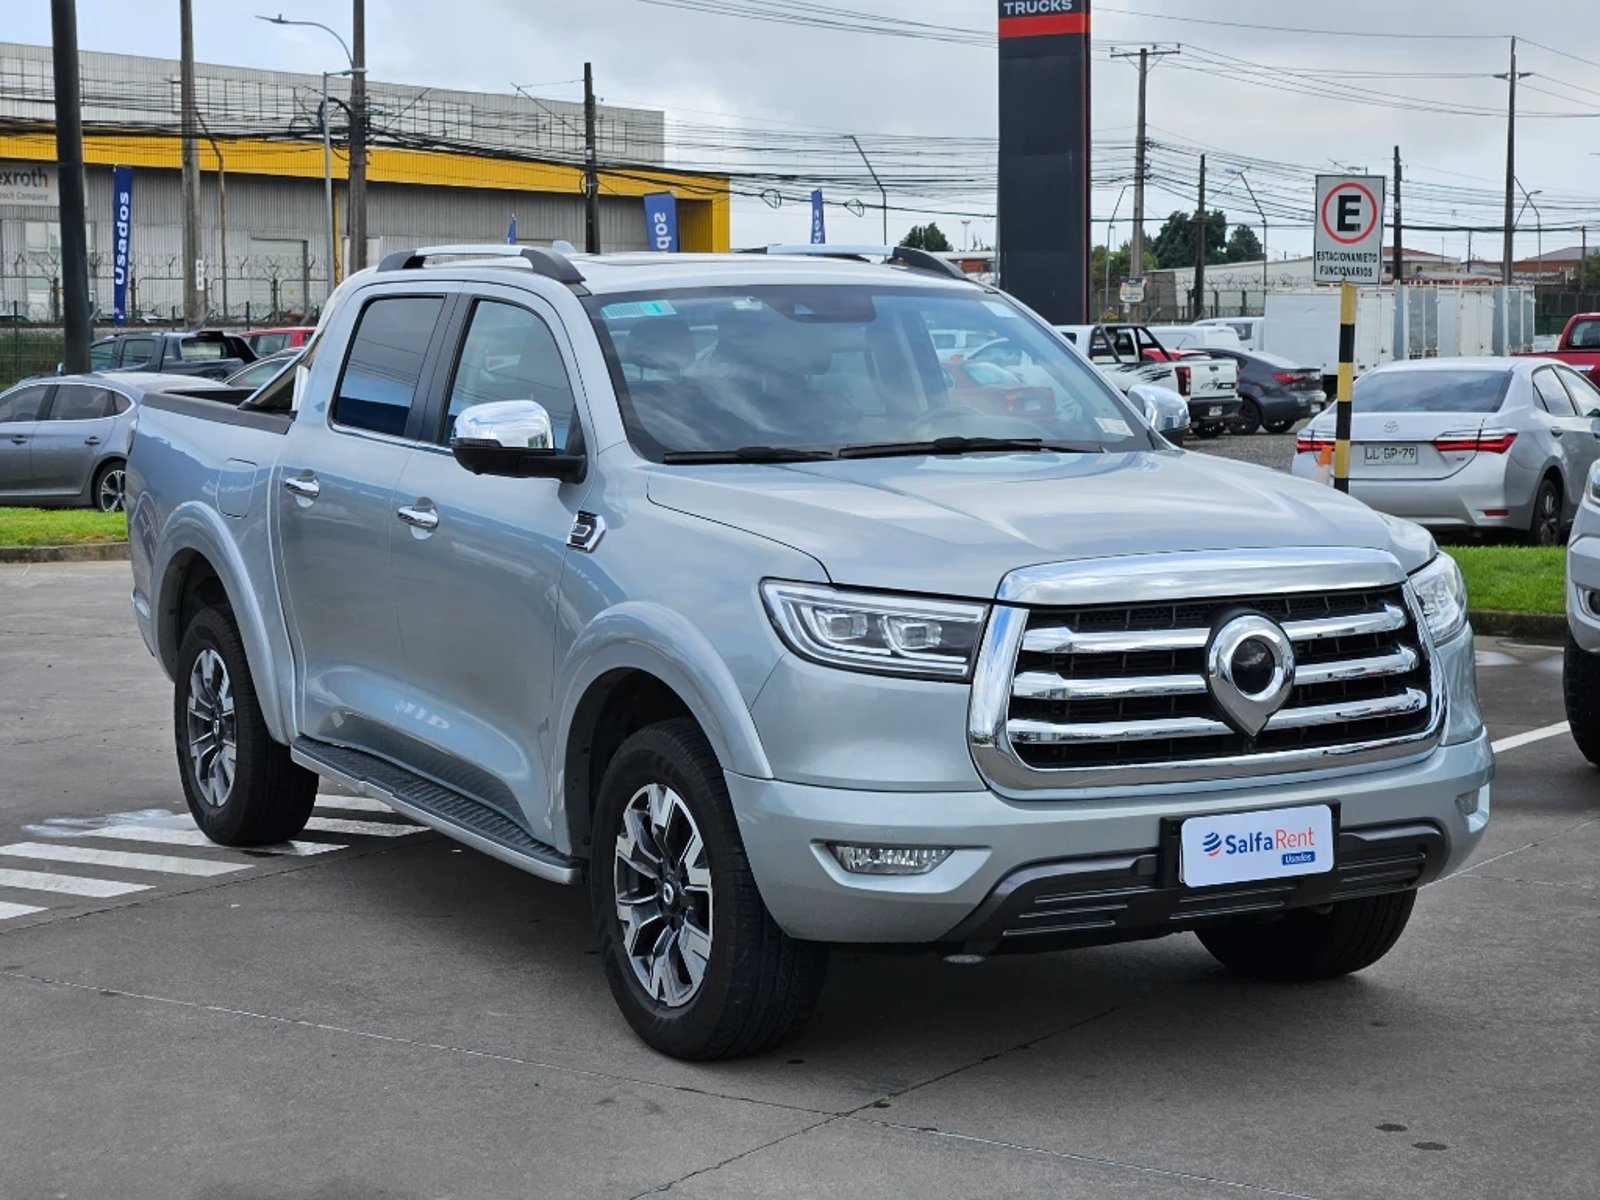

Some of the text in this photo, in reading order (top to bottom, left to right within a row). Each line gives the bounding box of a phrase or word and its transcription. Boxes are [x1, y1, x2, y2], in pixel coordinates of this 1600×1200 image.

[1003, 0, 1073, 15] TRUCKS
[1337, 195, 1361, 232] E
[115, 192, 129, 285] Usados
[1320, 265, 1372, 277] FUNCIONARIOS
[1285, 852, 1312, 864] Usados
